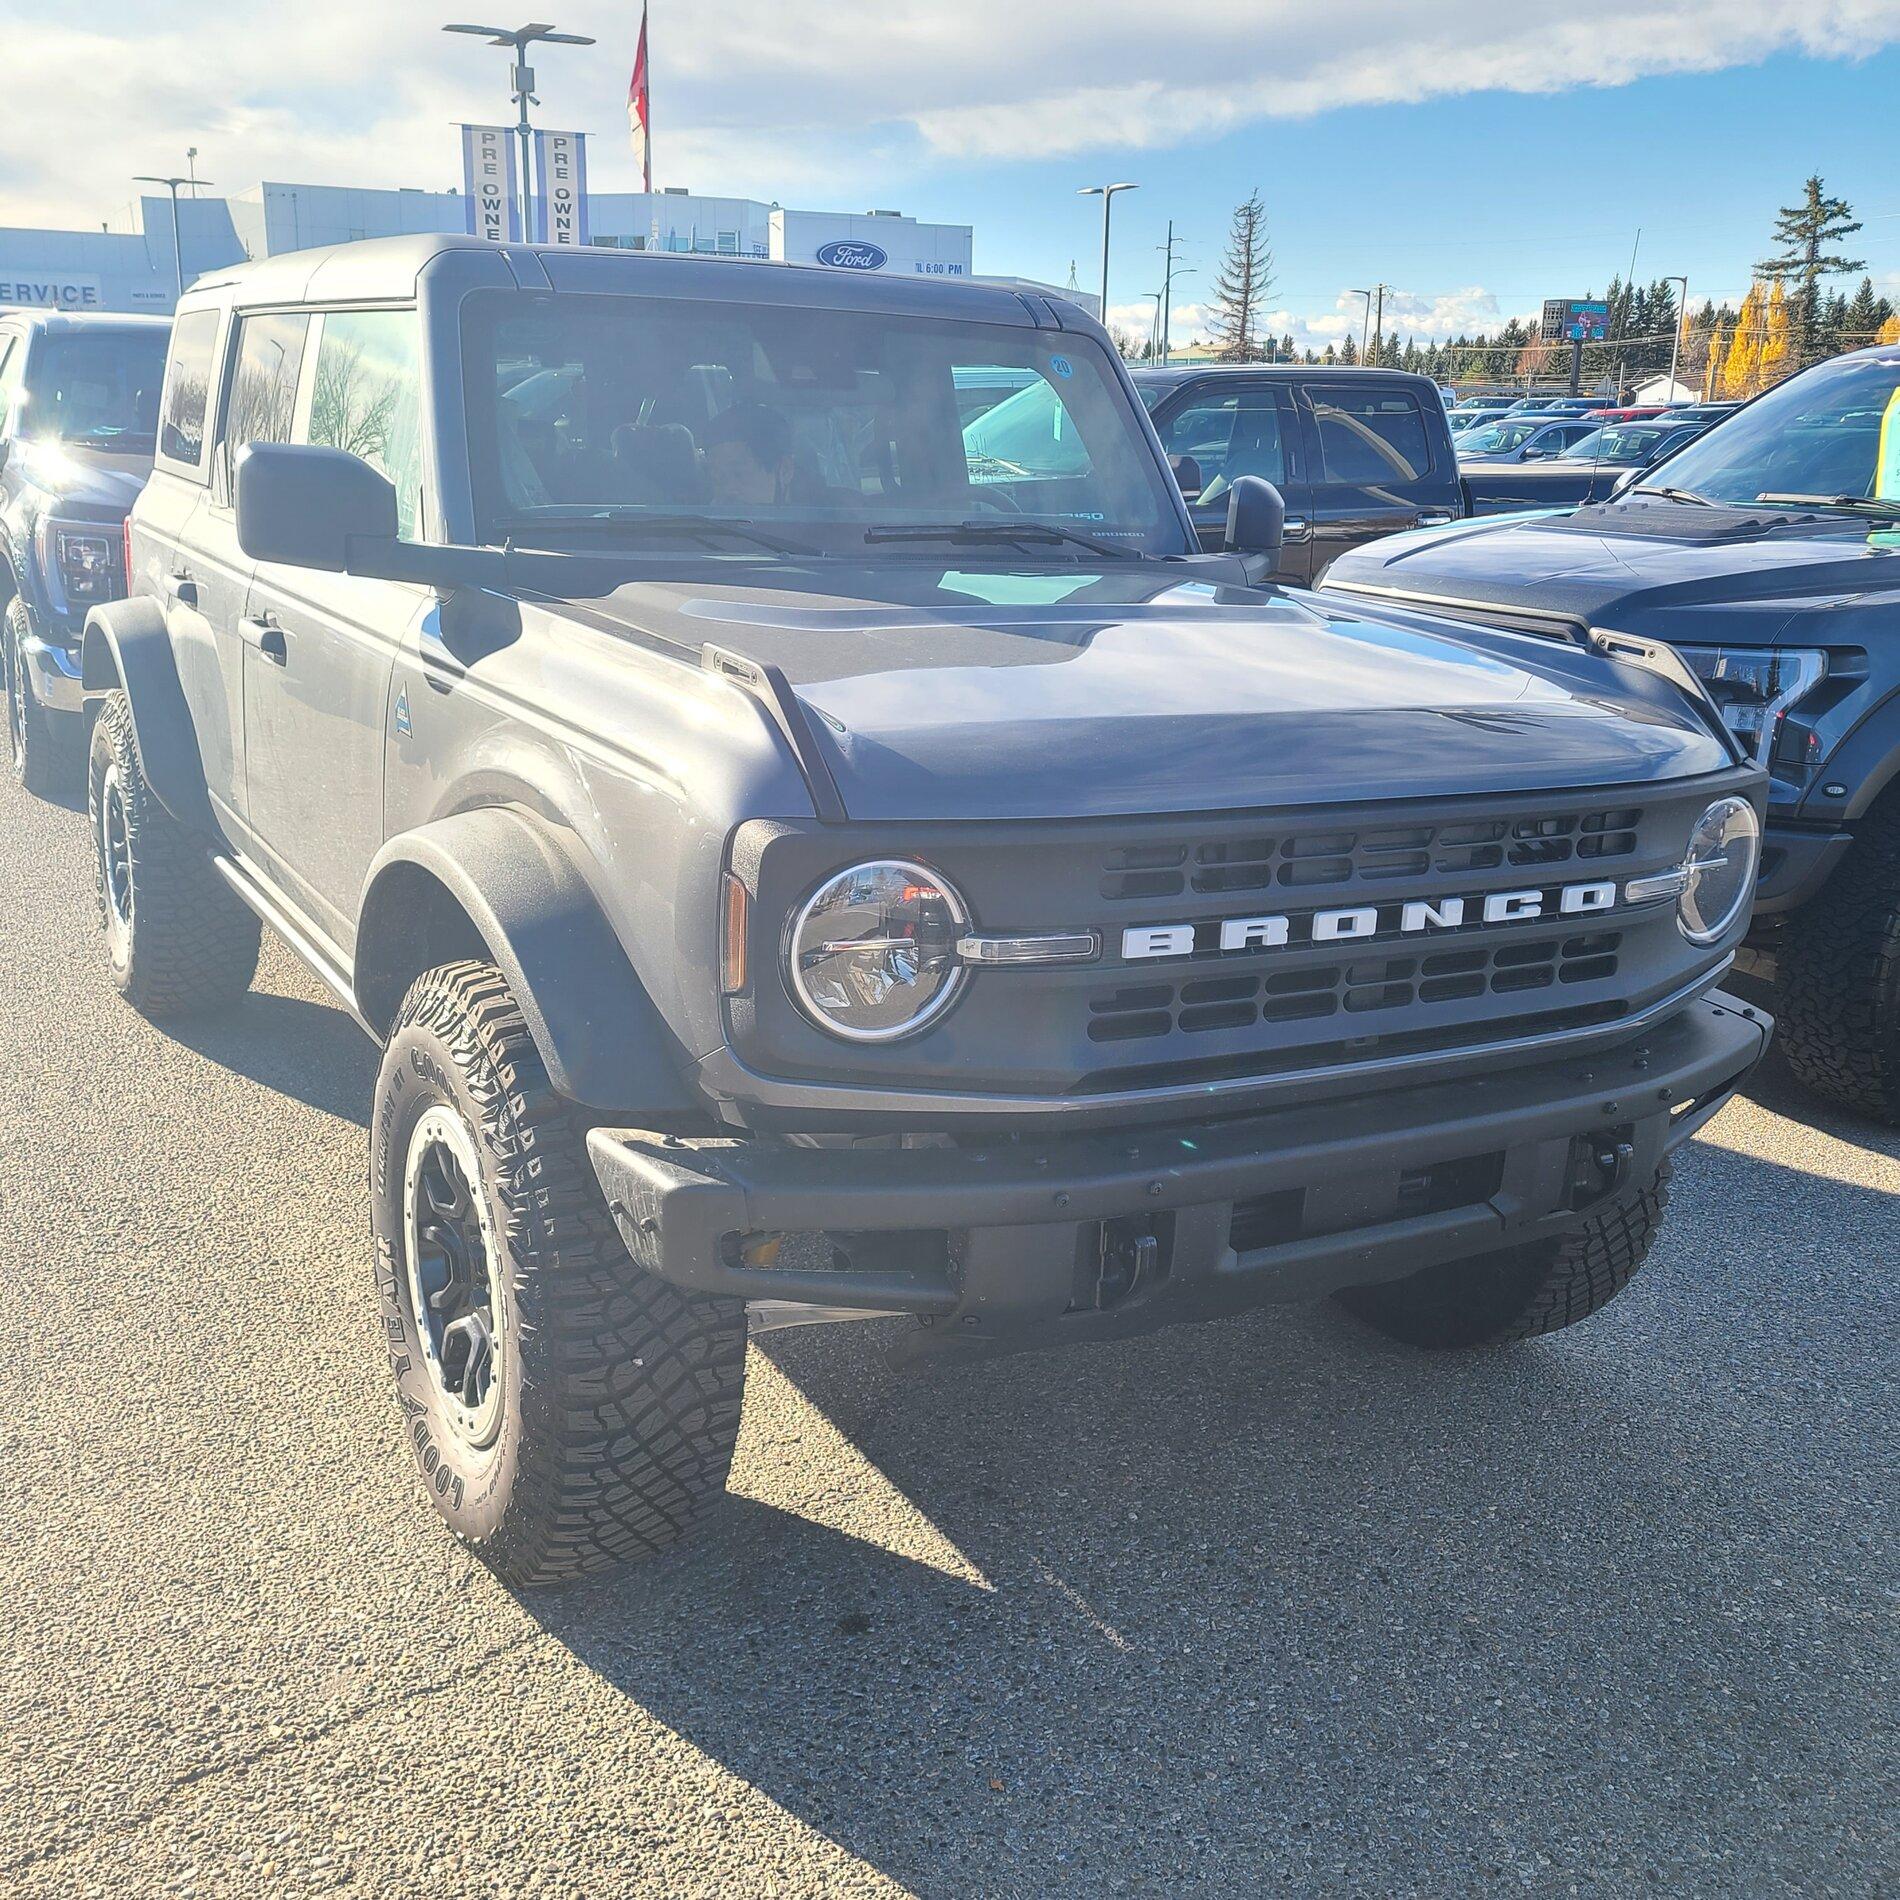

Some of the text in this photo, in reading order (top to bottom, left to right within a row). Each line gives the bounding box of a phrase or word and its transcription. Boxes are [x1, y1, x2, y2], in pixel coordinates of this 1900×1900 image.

[481, 132, 497, 175] PRE
[553, 138, 568, 179] PRE
[833, 245, 872, 267] Ford
[926, 263, 944, 274] 6:00
[948, 264, 963, 275] PM
[1121, 881, 1617, 960] BRONCO
